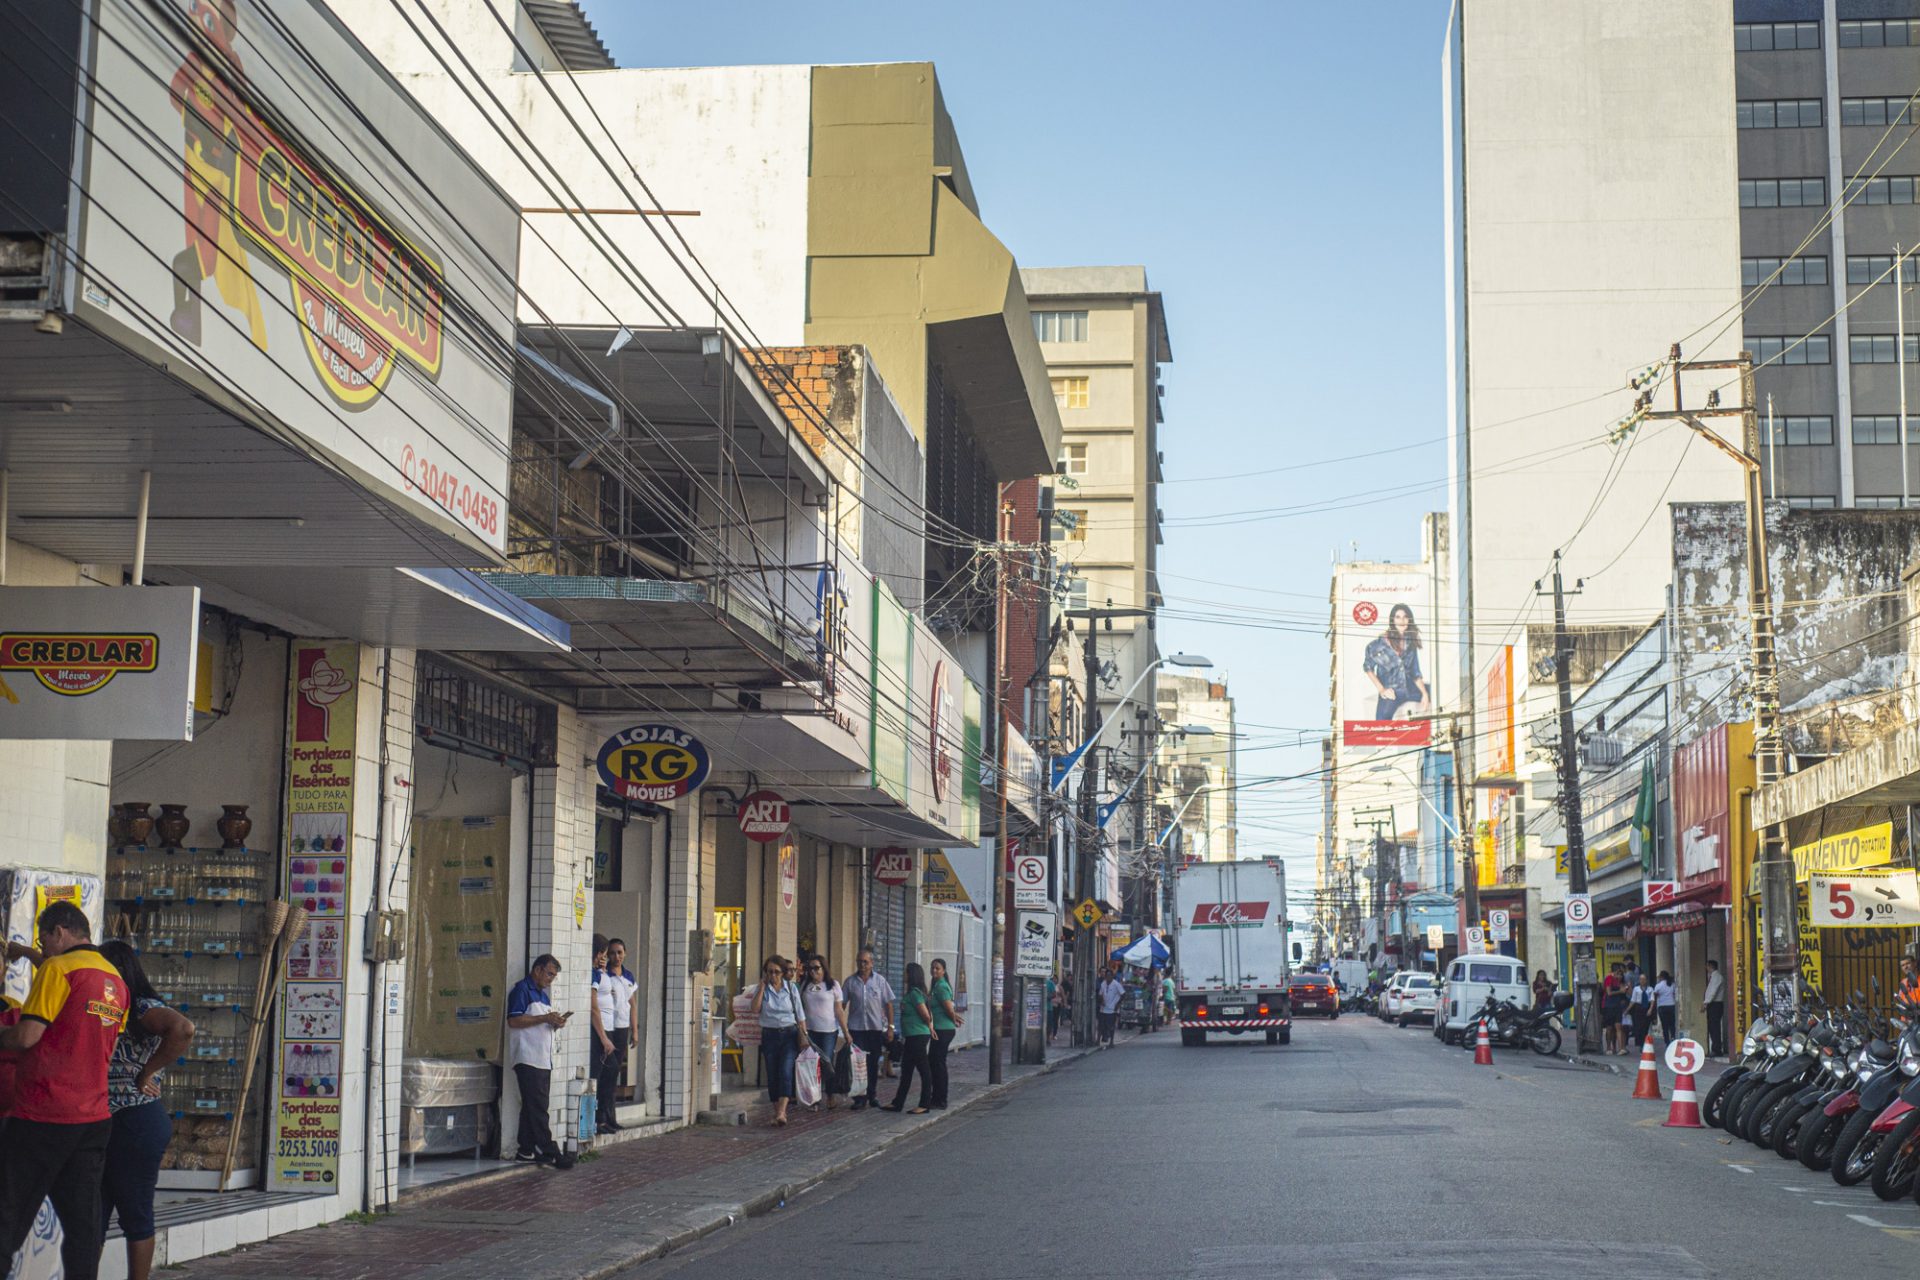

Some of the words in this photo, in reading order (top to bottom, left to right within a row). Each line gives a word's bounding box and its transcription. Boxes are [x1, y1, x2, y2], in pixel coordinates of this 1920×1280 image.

[257, 146, 429, 346] CREDLAR
[419, 457, 498, 536] 3047-0458
[12, 641, 144, 664] CREDLAR
[615, 727, 694, 747] LOJAS
[293, 746, 352, 761] Fortaleza
[310, 760, 334, 774] das
[621, 748, 689, 781] RG
[292, 773, 351, 788] Essências
[293, 790, 321, 800] TUDO
[323, 790, 348, 800] PARA
[626, 783, 677, 801] MÓVEIS
[295, 802, 315, 811] SUA
[317, 801, 345, 811] FESTA
[740, 799, 786, 831] ART
[875, 854, 906, 876] ART
[1673, 1041, 1696, 1073] 5
[281, 1101, 339, 1114] Fortaleza
[299, 1113, 322, 1126] das
[280, 1126, 339, 1139] Essências
[278, 1139, 339, 1158] 3253.5049
